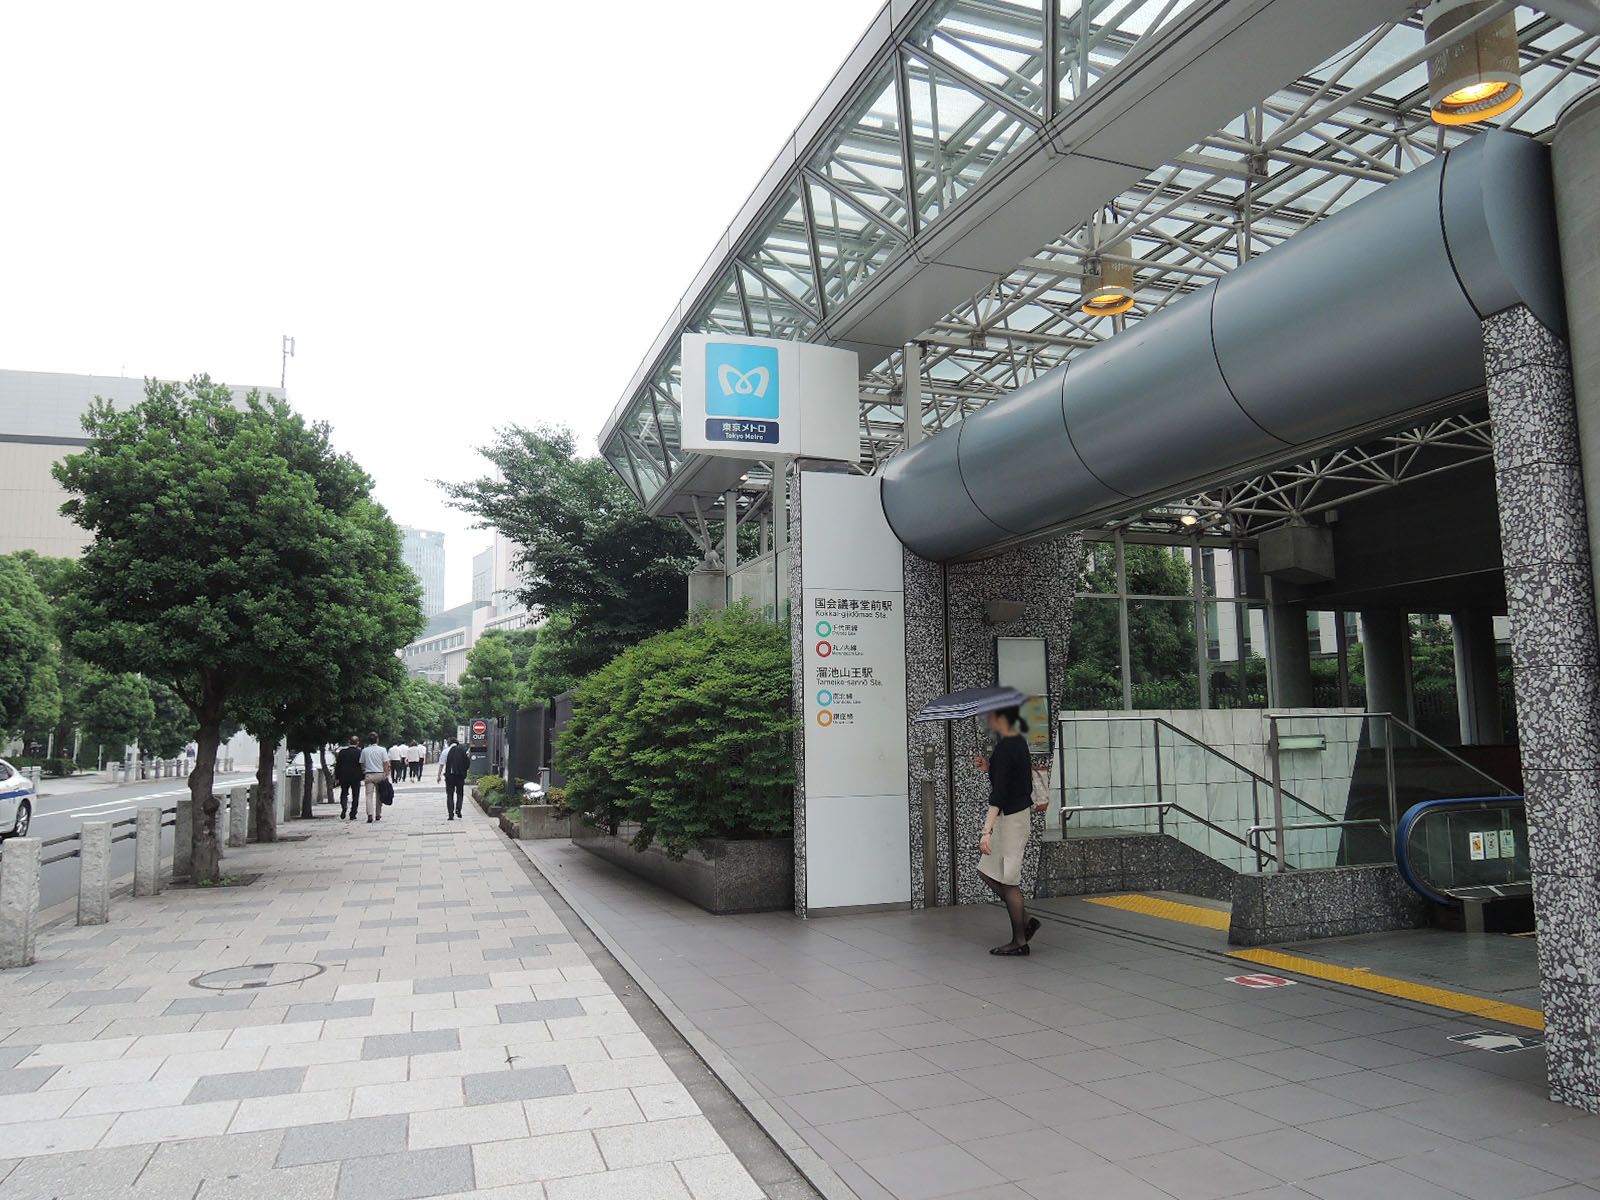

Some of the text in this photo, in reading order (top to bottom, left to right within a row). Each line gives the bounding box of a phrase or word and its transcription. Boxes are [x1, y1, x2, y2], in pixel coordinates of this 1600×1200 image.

[722, 422, 766, 433] 東京メトロ
[815, 598, 892, 611] 国会議事堂前駅
[816, 666, 873, 679] 溜池山王駅
